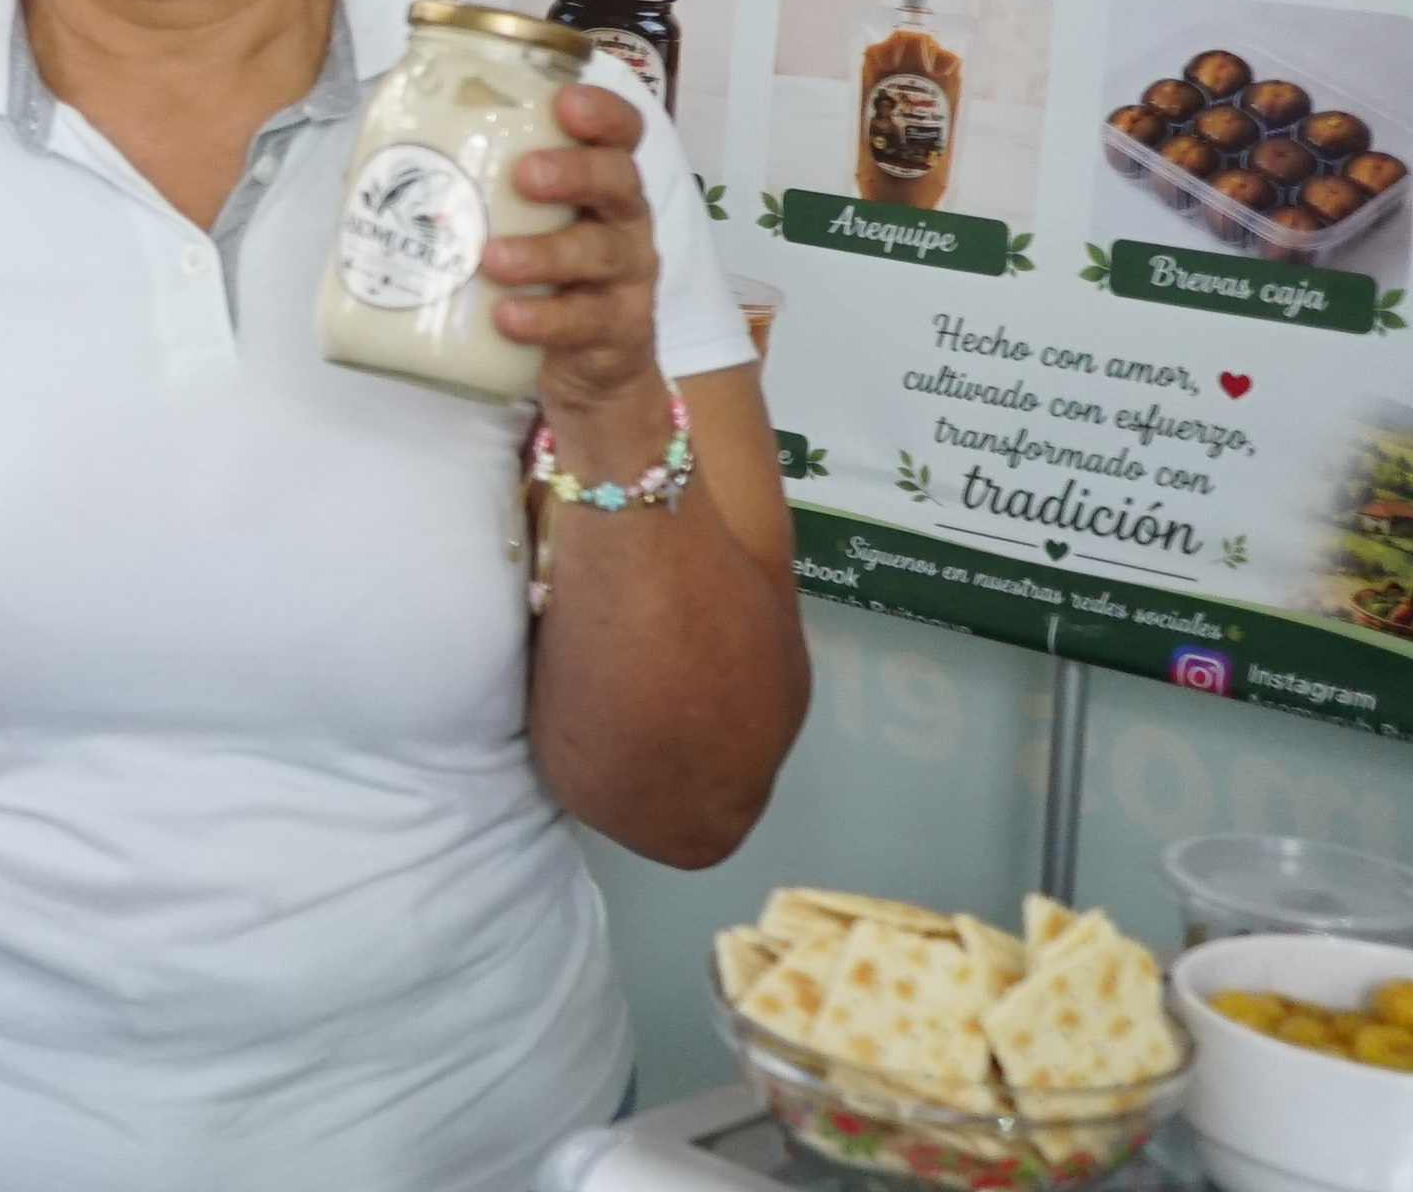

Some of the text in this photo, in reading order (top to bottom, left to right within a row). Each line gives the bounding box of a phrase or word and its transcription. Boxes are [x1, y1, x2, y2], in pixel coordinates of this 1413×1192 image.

[827, 205, 960, 259] Arequipe
[1148, 254, 1329, 318] Brevas caja
[932, 313, 1201, 396] Hecho con amor,
[902, 365, 1257, 458] cultivado con esfuerzo,
[933, 416, 1215, 495] transformado con
[961, 464, 1204, 555] tradición
[942, 565, 971, 583] en
[973, 572, 1064, 604] nuestras
[1071, 591, 1127, 619] redes
[1131, 607, 1222, 641] sociales
[1247, 662, 1376, 710] Instagram
